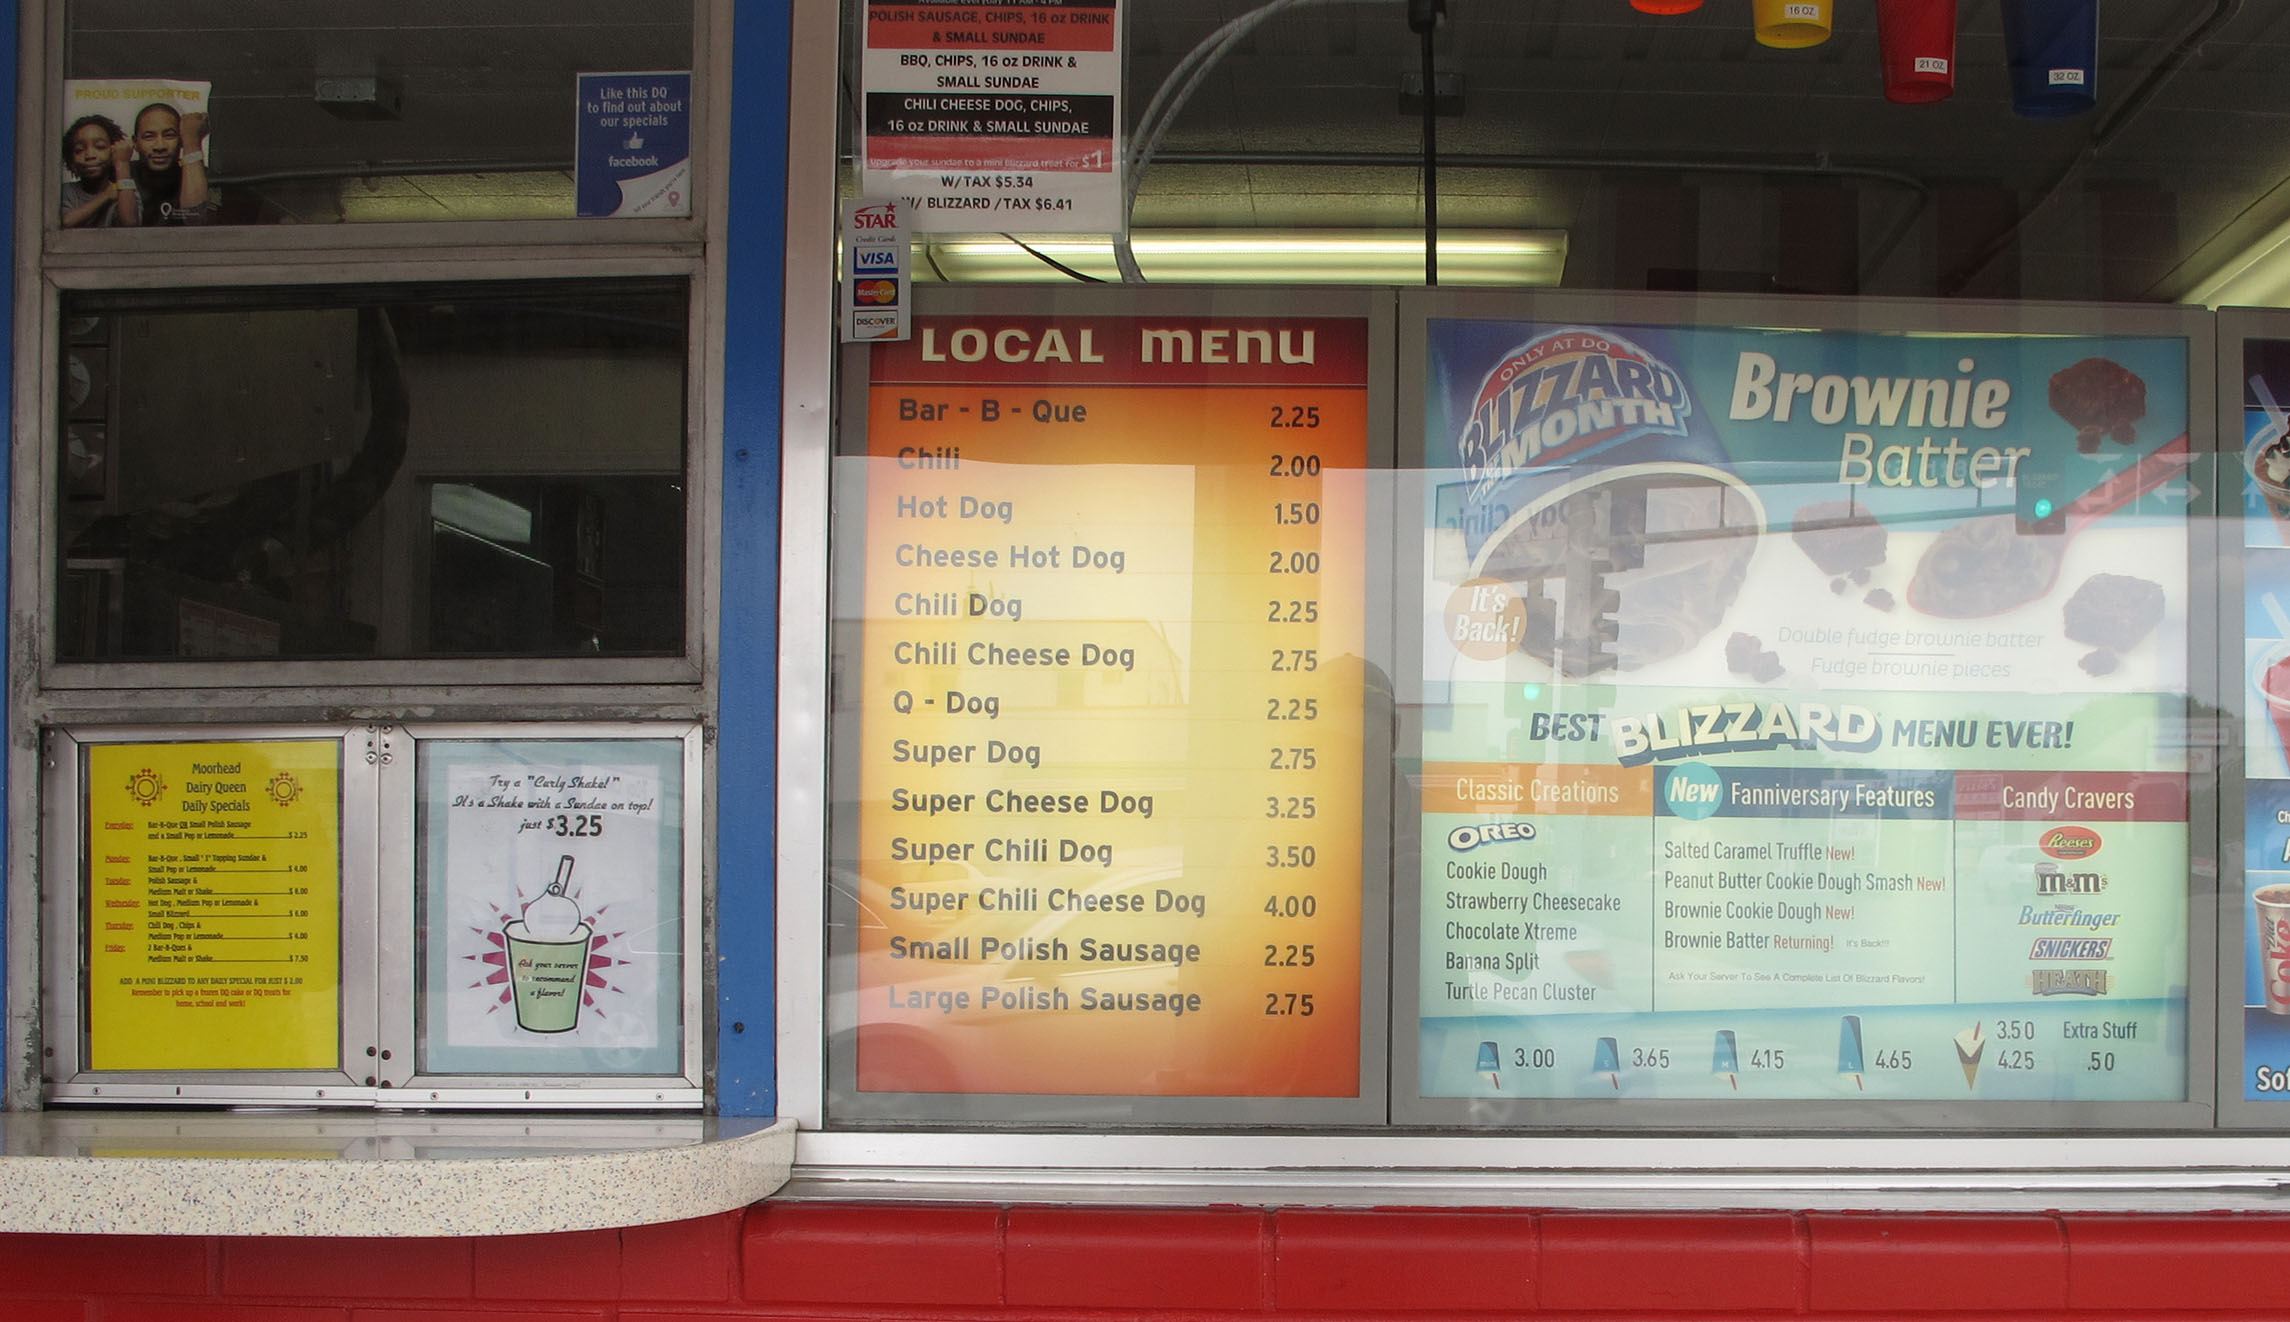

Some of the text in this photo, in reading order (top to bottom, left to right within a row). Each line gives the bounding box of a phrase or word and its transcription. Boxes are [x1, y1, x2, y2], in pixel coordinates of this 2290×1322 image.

[869, 11, 1109, 24] POLISH SAUSAGE, CHIPS, 16 oz DRINK
[1788, 5, 1799, 15] 16
[901, 55, 1077, 68] BBQ, CHIPS, 16 oz DRINK &
[1919, 59, 1929, 69] 21
[937, 77, 1039, 88] SMALL SUNDAE
[2053, 71, 2064, 81] 32
[75, 88, 200, 99] PROUD SUPPORTER
[601, 87, 667, 99] Like this DQ
[588, 101, 682, 113] to find out about
[904, 99, 1072, 113] CHILI CHEESE DOG, CHIPS,
[601, 115, 668, 128] our specials
[609, 156, 658, 167] facebook
[942, 176, 1033, 188] W/TAX $5.34
[928, 198, 990, 209] BLIZZARD
[1036, 198, 1072, 211] $6.41
[854, 214, 896, 229] STAR
[861, 252, 894, 264] VISA
[922, 328, 1105, 363] LOCAL
[1500, 339, 1610, 382] ONLY AT DQ
[1729, 351, 2011, 429] Brownie
[900, 400, 949, 421] Bar
[982, 400, 1000, 421] B
[1033, 401, 1087, 423] Que
[1270, 407, 1319, 428] 2.25
[1459, 353, 1687, 502] BLIZZARD
[1499, 399, 1675, 469] MONTH
[898, 447, 1320, 477] Chili 2.00
[1839, 432, 2031, 488] Batter
[897, 496, 1319, 525] Hot Dog 1.50
[1470, 587, 1507, 614] It's
[1454, 615, 1519, 643] Back!
[1778, 627, 2044, 650] Double fudge brownie batter
[1811, 657, 2011, 679] Fudge brownie pieces
[1530, 702, 2074, 768] BEST BLIZZARD MENU EVER!
[192, 763, 241, 774] Moorhead
[187, 782, 246, 794] Dairy Queen
[490, 775, 510, 790] Try
[1457, 778, 1619, 803] Classic Creations
[1670, 776, 1719, 803] New
[183, 801, 250, 813] Daily Specials
[452, 795, 474, 808] It's
[488, 797, 524, 808] Shake
[527, 798, 551, 809] with
[565, 798, 607, 810] Sundae
[629, 799, 653, 812] top!
[1732, 783, 1935, 811] Fanniversary Features
[2003, 786, 2134, 814] Candy Cravers
[518, 819, 542, 833] just
[1448, 822, 1536, 851] OREO
[1665, 841, 1855, 861] Salted Caramel Truffle New!
[1447, 861, 1547, 884] Cookie Dough
[891, 887, 1317, 918] Super Chili Cheese Dog 4.00
[1446, 892, 1621, 915] Strawberry Cheesecake
[2018, 905, 2121, 931] Butterfinger
[890, 937, 1315, 966] Small Polish Sausage 2.25
[2033, 940, 2109, 959] SNICKERS
[2032, 969, 2107, 996] HEATH
[889, 986, 1314, 1016] Large Polish Sausage 2.75
[2064, 1022, 2137, 1040] Extra Stuff
[1515, 1047, 1555, 1068] 3.00
[1875, 1050, 1912, 1070] 4.65
